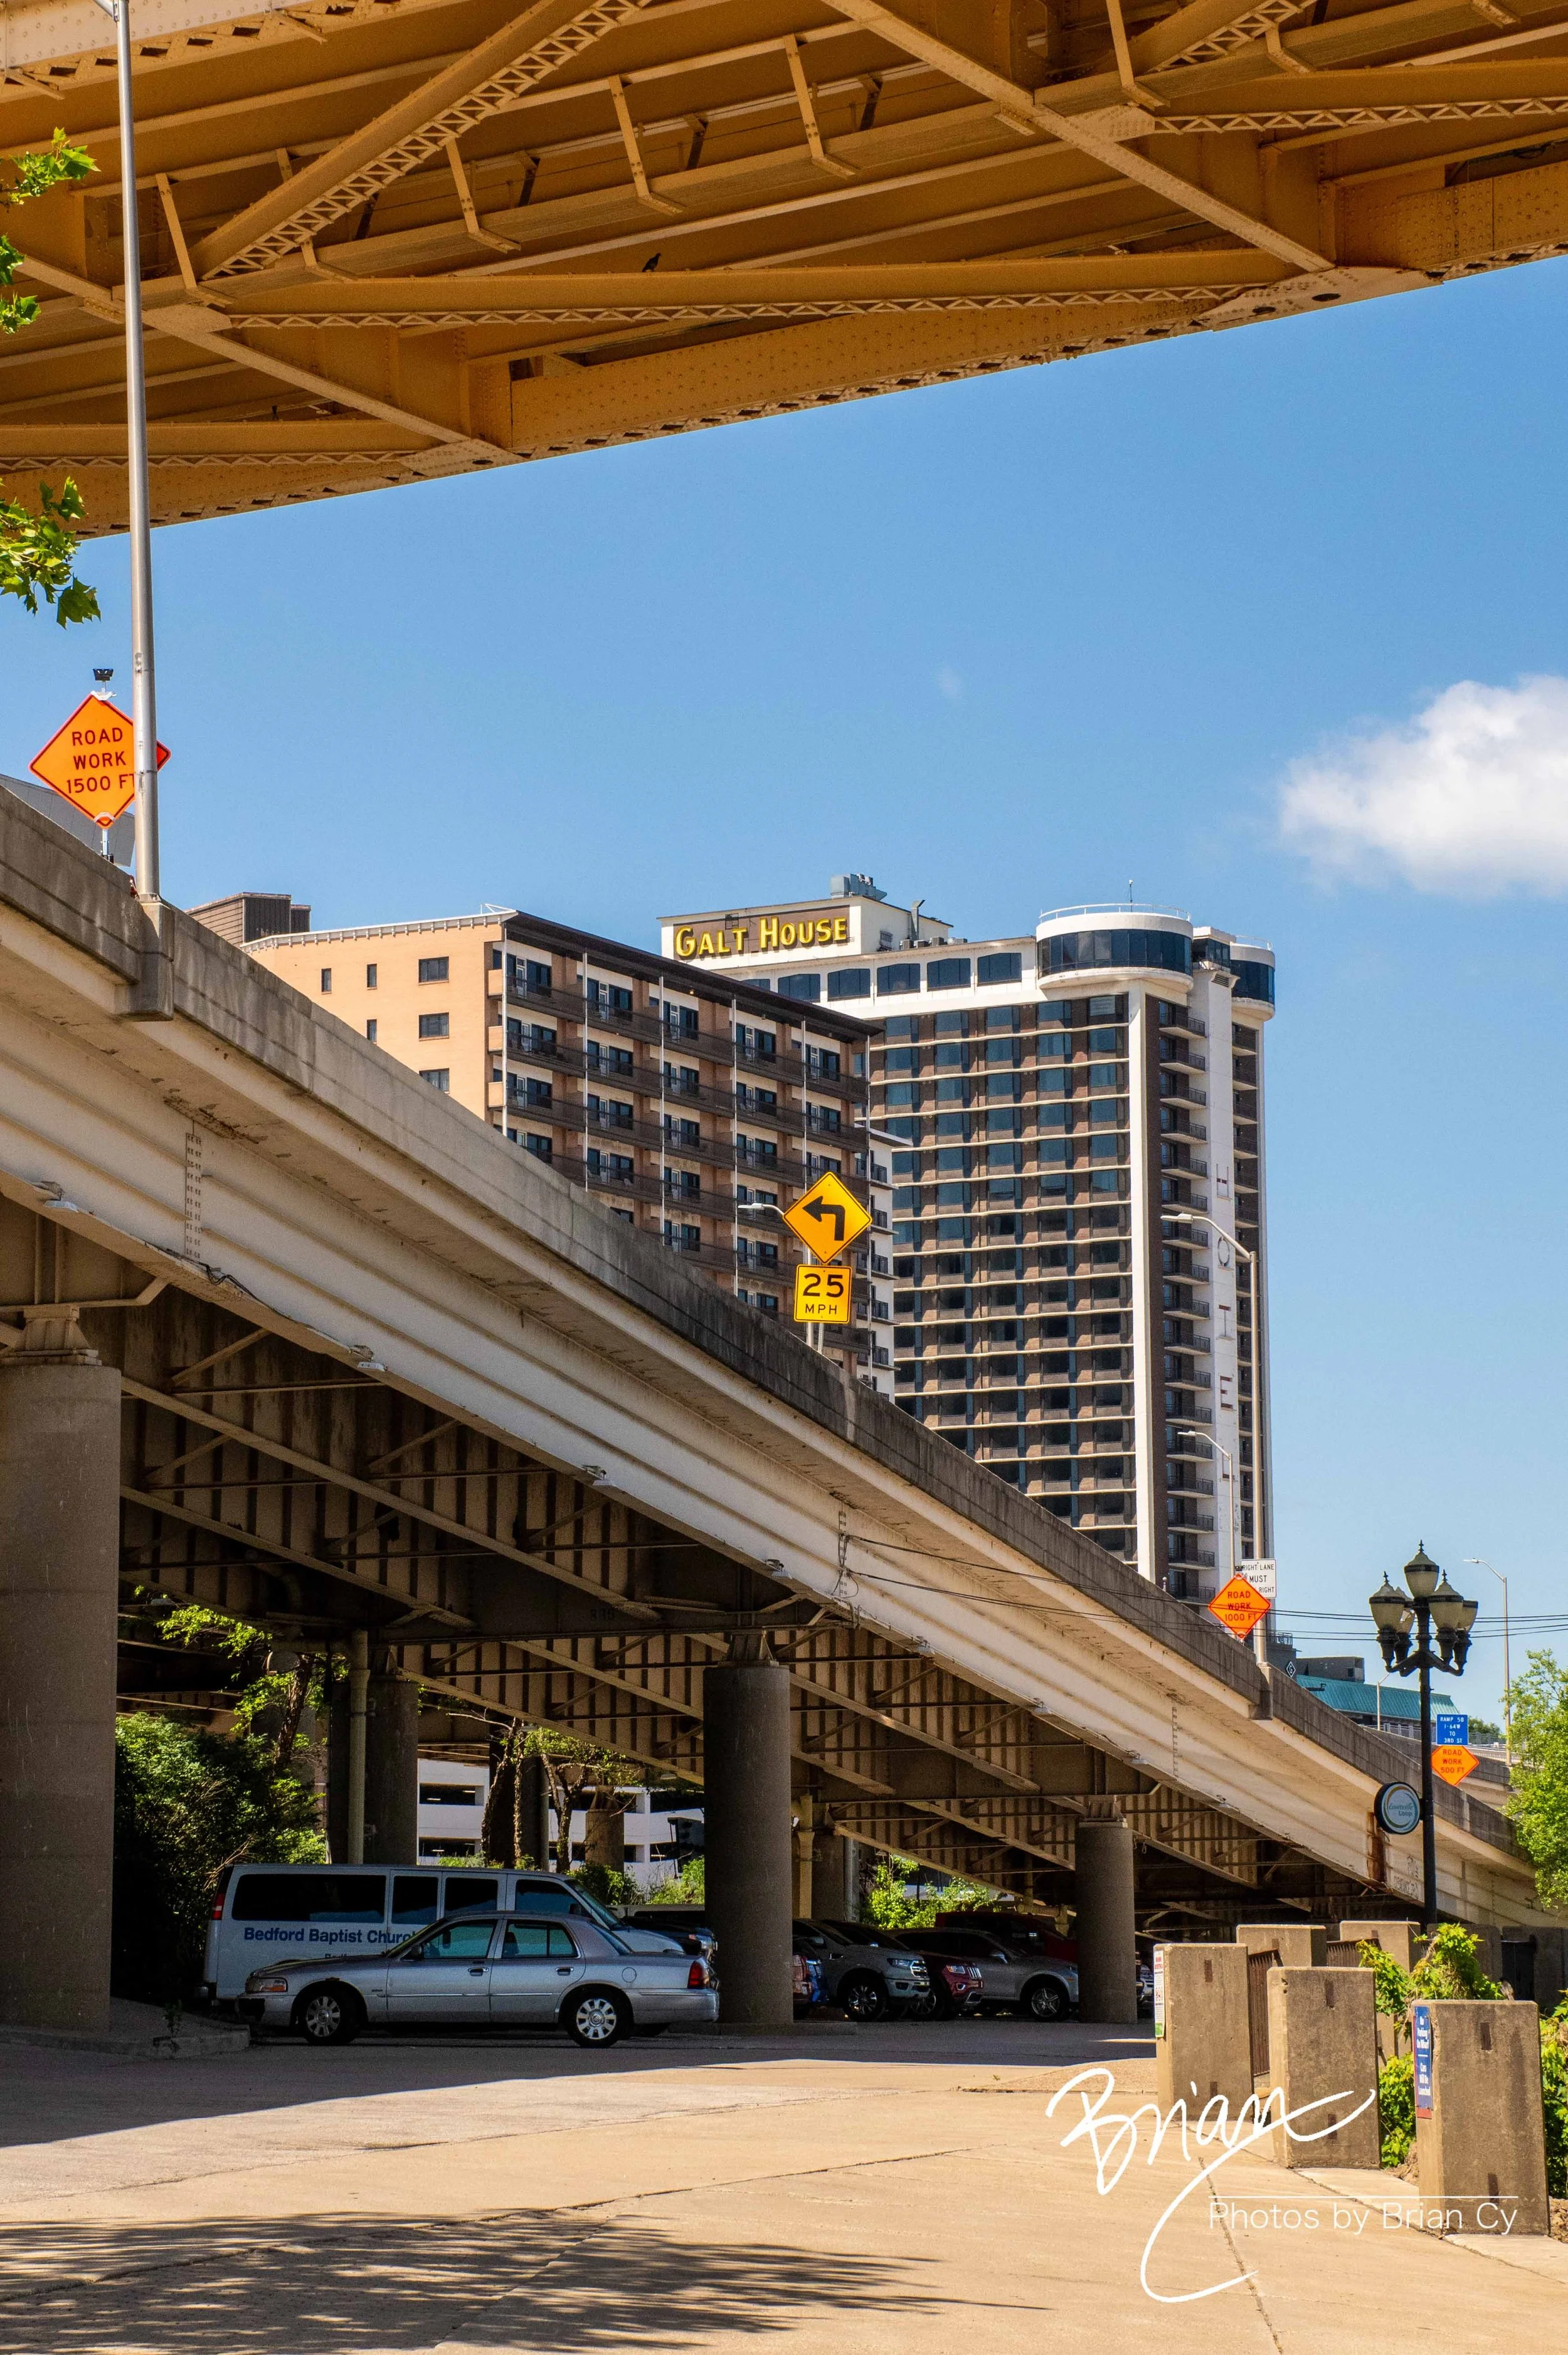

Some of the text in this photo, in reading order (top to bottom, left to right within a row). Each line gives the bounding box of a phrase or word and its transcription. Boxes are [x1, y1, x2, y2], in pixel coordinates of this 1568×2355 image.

[72, 728, 123, 746] ROAD
[73, 751, 127, 770] WORK
[66, 775, 110, 794] 1500
[675, 916, 847, 957] GALT HOUSE
[803, 1273, 844, 1298] 25
[805, 1303, 837, 1315] MPH
[1228, 1590, 1251, 1599] ROAD
[1228, 1602, 1251, 1611] WORK
[244, 1927, 416, 1945] Bedford Baptist Churc
